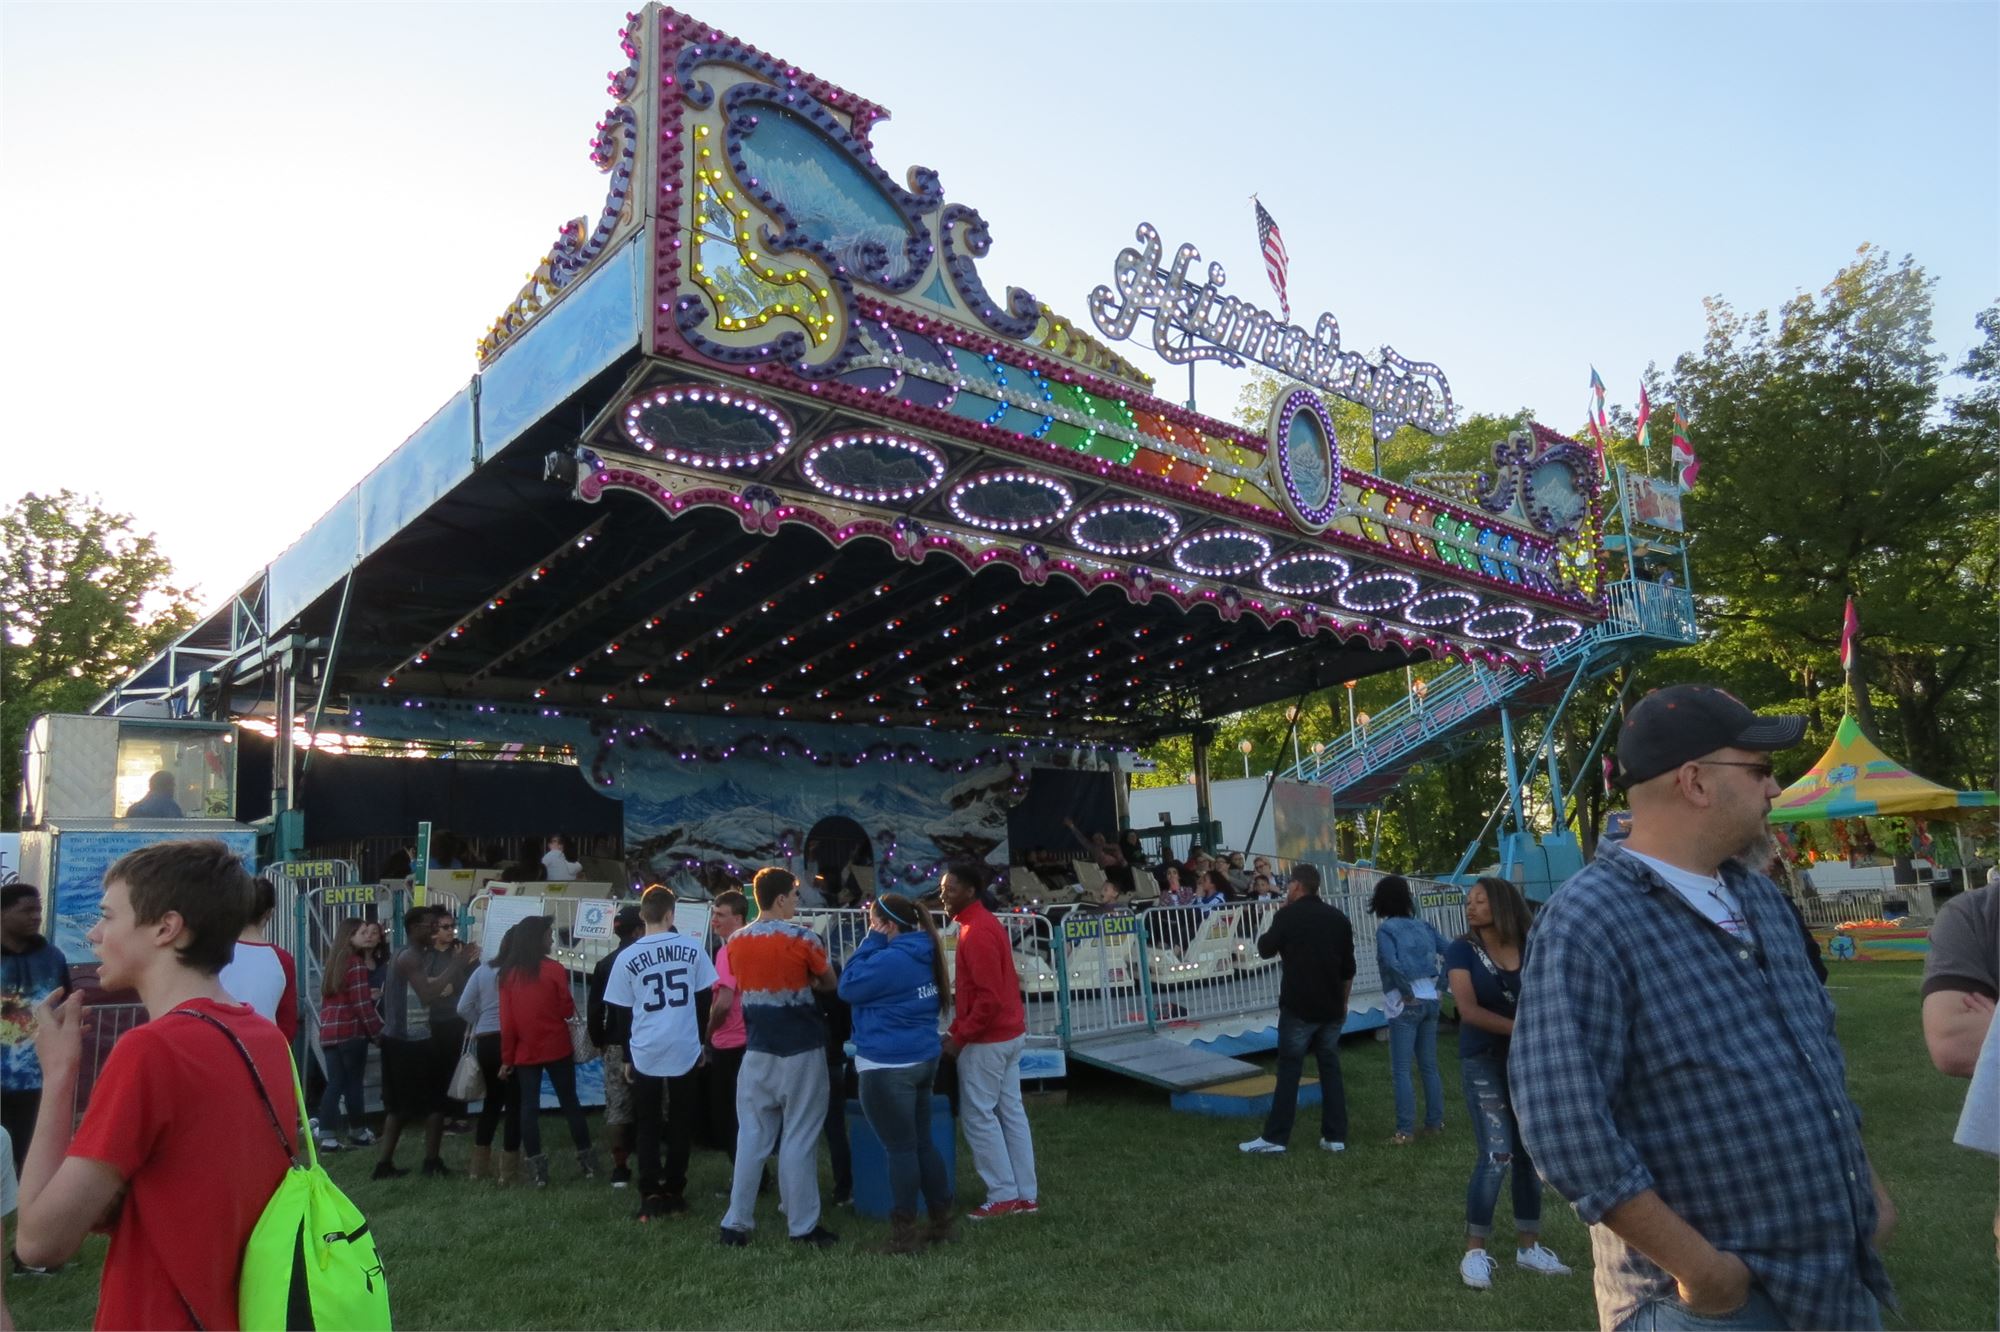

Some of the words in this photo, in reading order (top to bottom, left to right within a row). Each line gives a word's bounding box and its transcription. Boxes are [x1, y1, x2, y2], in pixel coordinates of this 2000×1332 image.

[1087, 222, 1453, 441] Himalaya
[286, 862, 333, 877] ENTER
[325, 887, 375, 904] ENTER
[1422, 894, 1442, 908] EXIT
[1446, 892, 1463, 905] EXIT
[580, 925, 607, 934] TICKETS
[1066, 920, 1098, 938] EXIT
[1104, 917, 1135, 934] EXIT
[626, 945, 698, 977] VERLANDER
[642, 968, 689, 1012] 35
